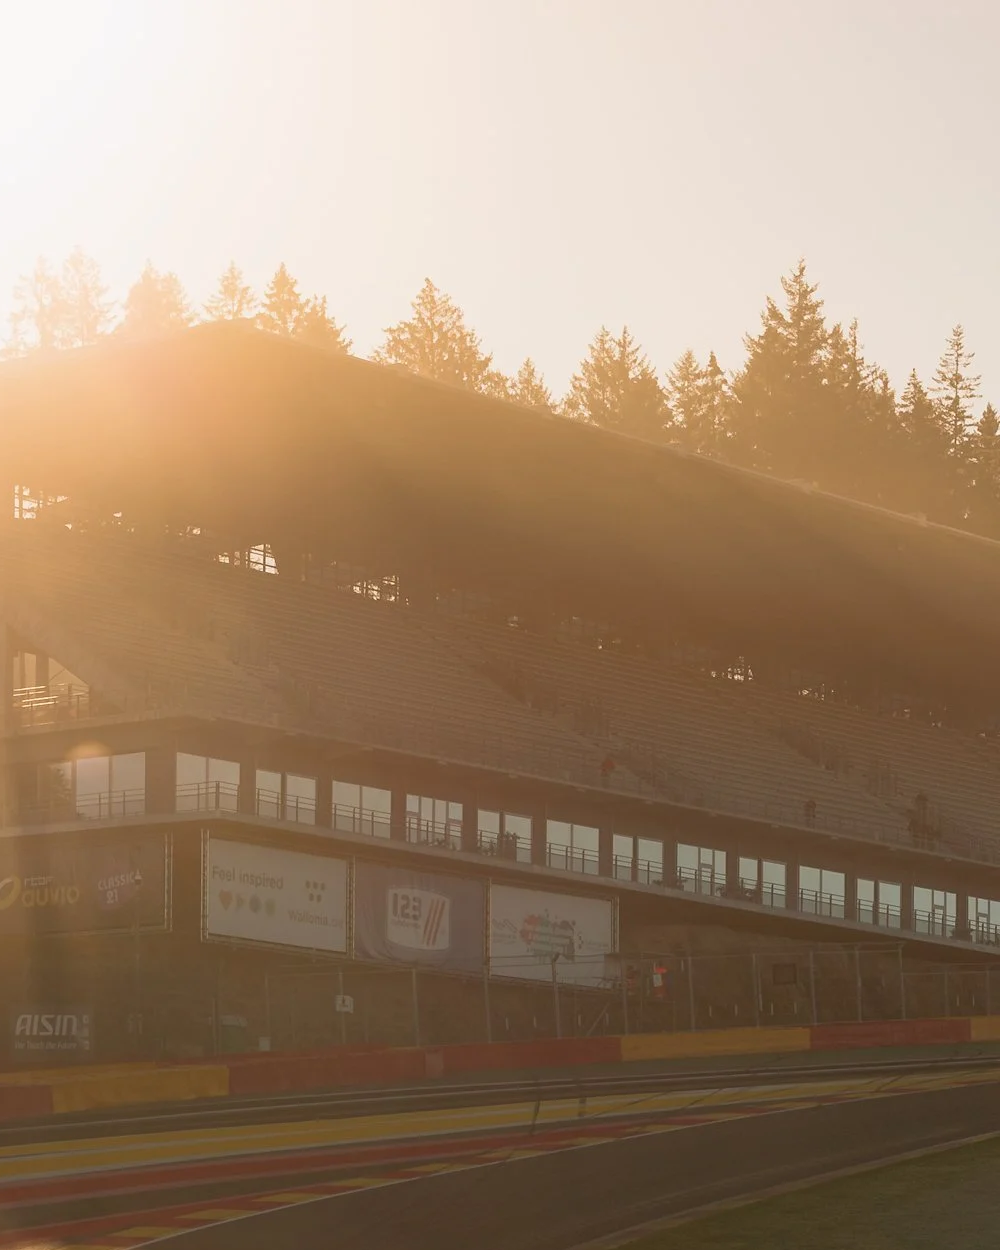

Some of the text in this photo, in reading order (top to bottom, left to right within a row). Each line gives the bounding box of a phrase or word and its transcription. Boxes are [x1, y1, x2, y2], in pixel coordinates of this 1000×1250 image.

[212, 865, 284, 890] Feel inspired
[392, 892, 422, 921] 123
[14, 1013, 78, 1036] AISIN
